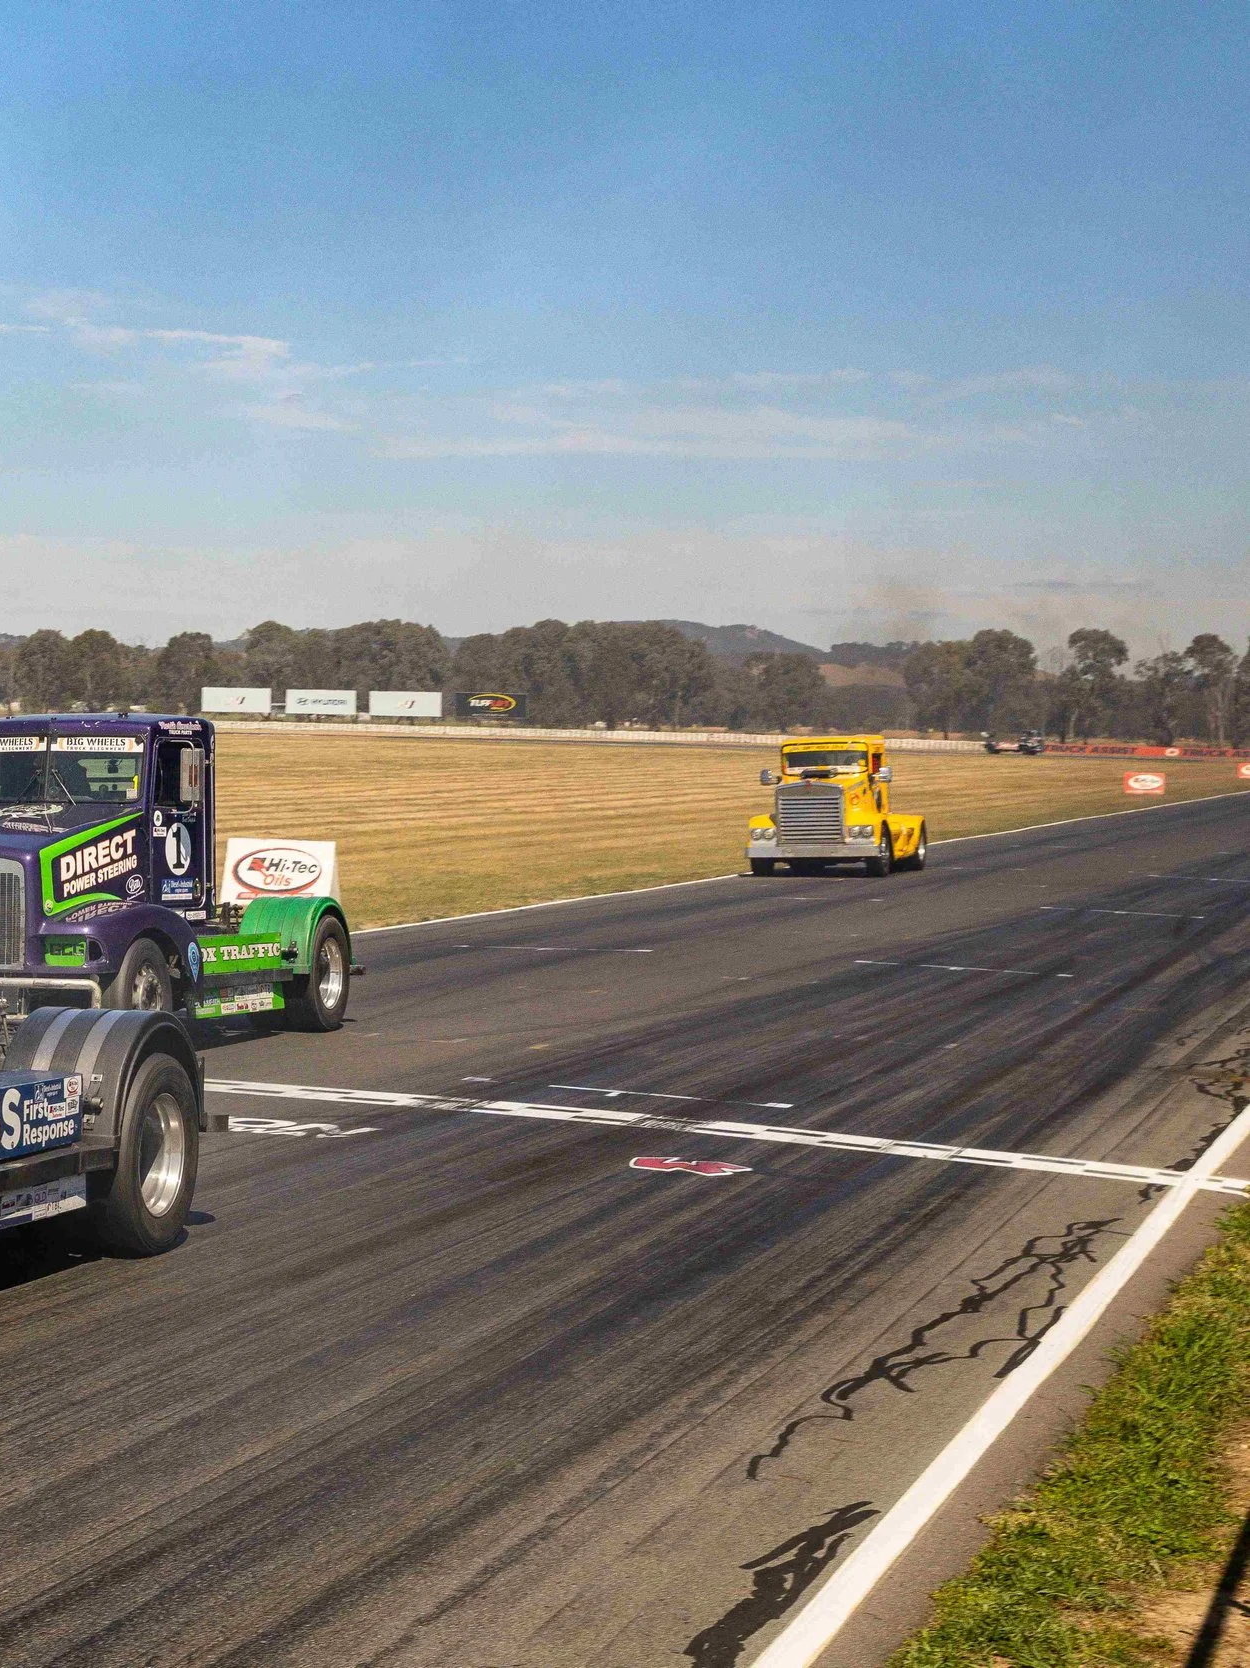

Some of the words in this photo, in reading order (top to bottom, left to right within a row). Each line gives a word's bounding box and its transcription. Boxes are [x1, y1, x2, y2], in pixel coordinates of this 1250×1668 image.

[0, 737, 33, 746] WHEELS
[66, 737, 82, 746] BIG
[85, 738, 126, 747] WHEELS
[60, 829, 136, 882] DIRECT
[172, 826, 185, 869] 1
[63, 872, 96, 898] POWER
[97, 854, 138, 884] STEERING
[266, 858, 318, 874] Hi-Tec
[263, 873, 292, 887] Oils
[220, 943, 281, 961] TRAFFIC
[23, 1098, 49, 1122] First
[22, 1119, 75, 1148] Response
